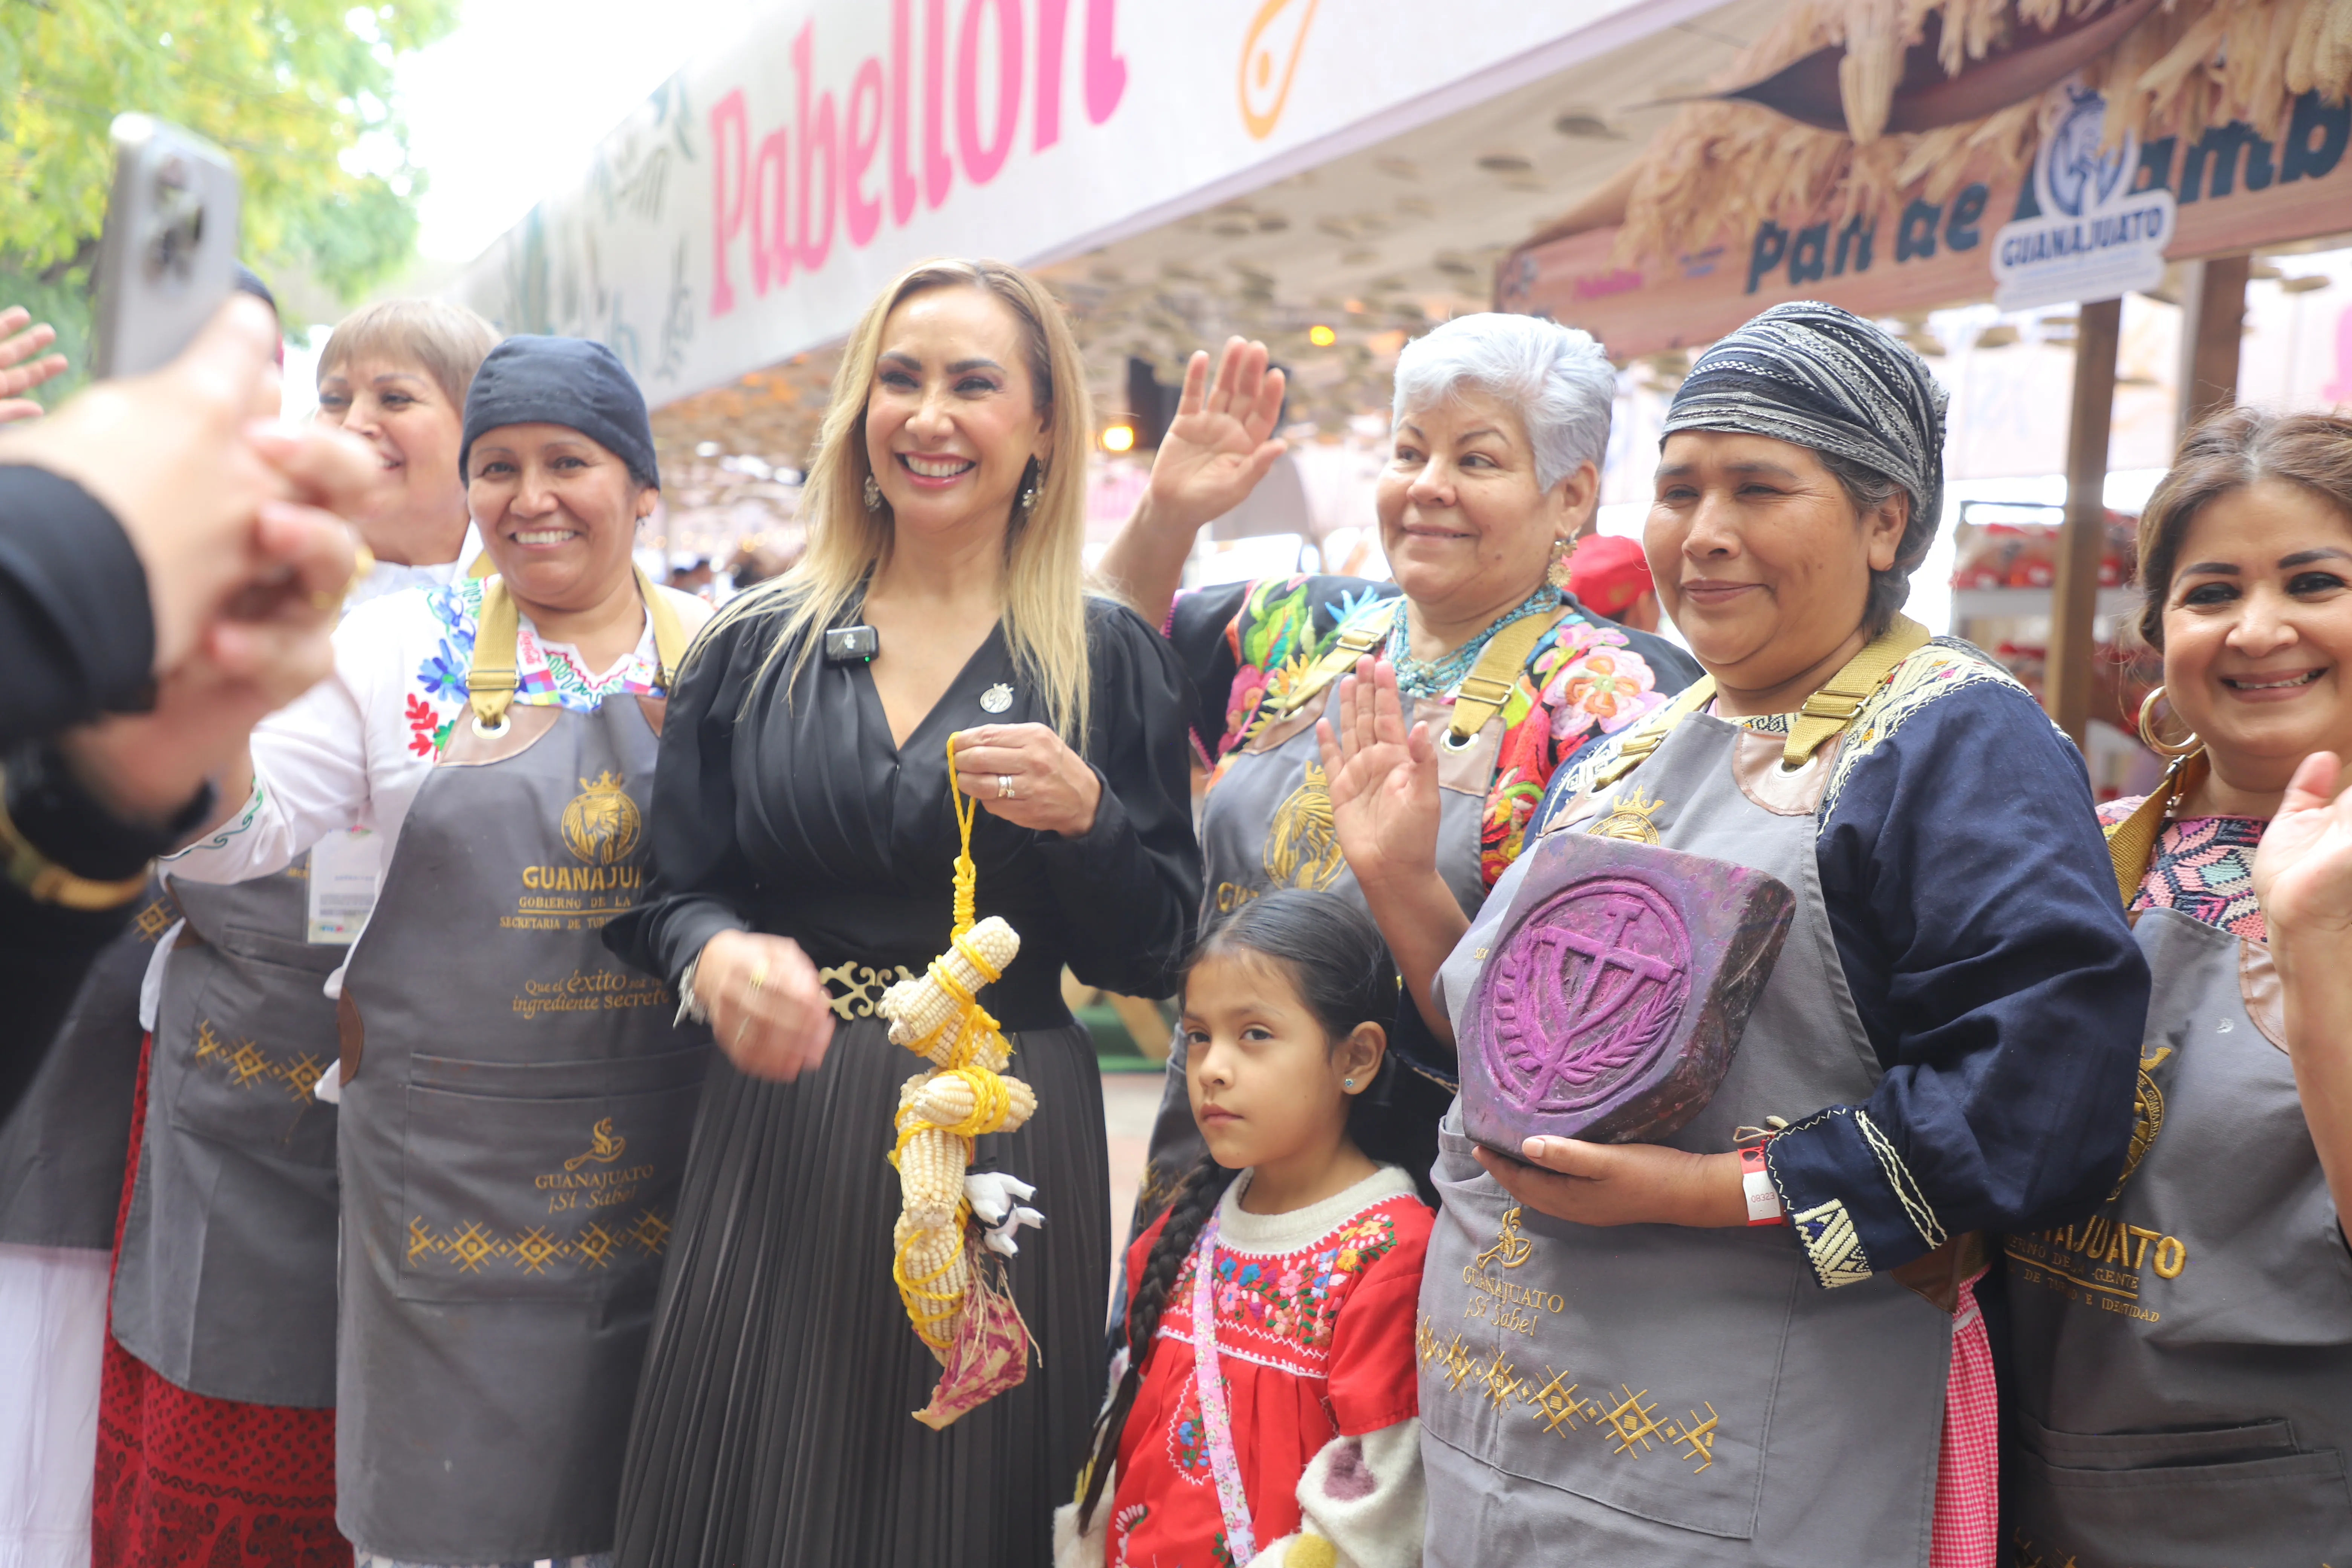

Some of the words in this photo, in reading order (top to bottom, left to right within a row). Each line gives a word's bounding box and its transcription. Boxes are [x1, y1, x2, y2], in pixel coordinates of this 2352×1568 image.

[519, 896, 582, 910] GOBIERNO
[590, 896, 606, 908] DE
[614, 896, 631, 907] LA
[499, 916, 560, 929] SECRETARIA
[567, 918, 581, 929] DE
[525, 980, 550, 996] Que
[552, 978, 564, 992] el
[567, 969, 627, 993] éxito
[512, 992, 600, 1020] ingrediente
[535, 1164, 654, 1190] GUANAJUATO
[1750, 1192, 1775, 1203] 08323
[2051, 1252, 2070, 1268] DE
[2093, 1268, 2139, 1289] GENTE
[1462, 1266, 1565, 1313] GUANAJUATO
[2024, 1268, 2041, 1283] DE
[2085, 1293, 2093, 1305] E
[2102, 1297, 2160, 1323] IDENTIDAD
[1491, 1304, 1537, 1336] Sabe!
